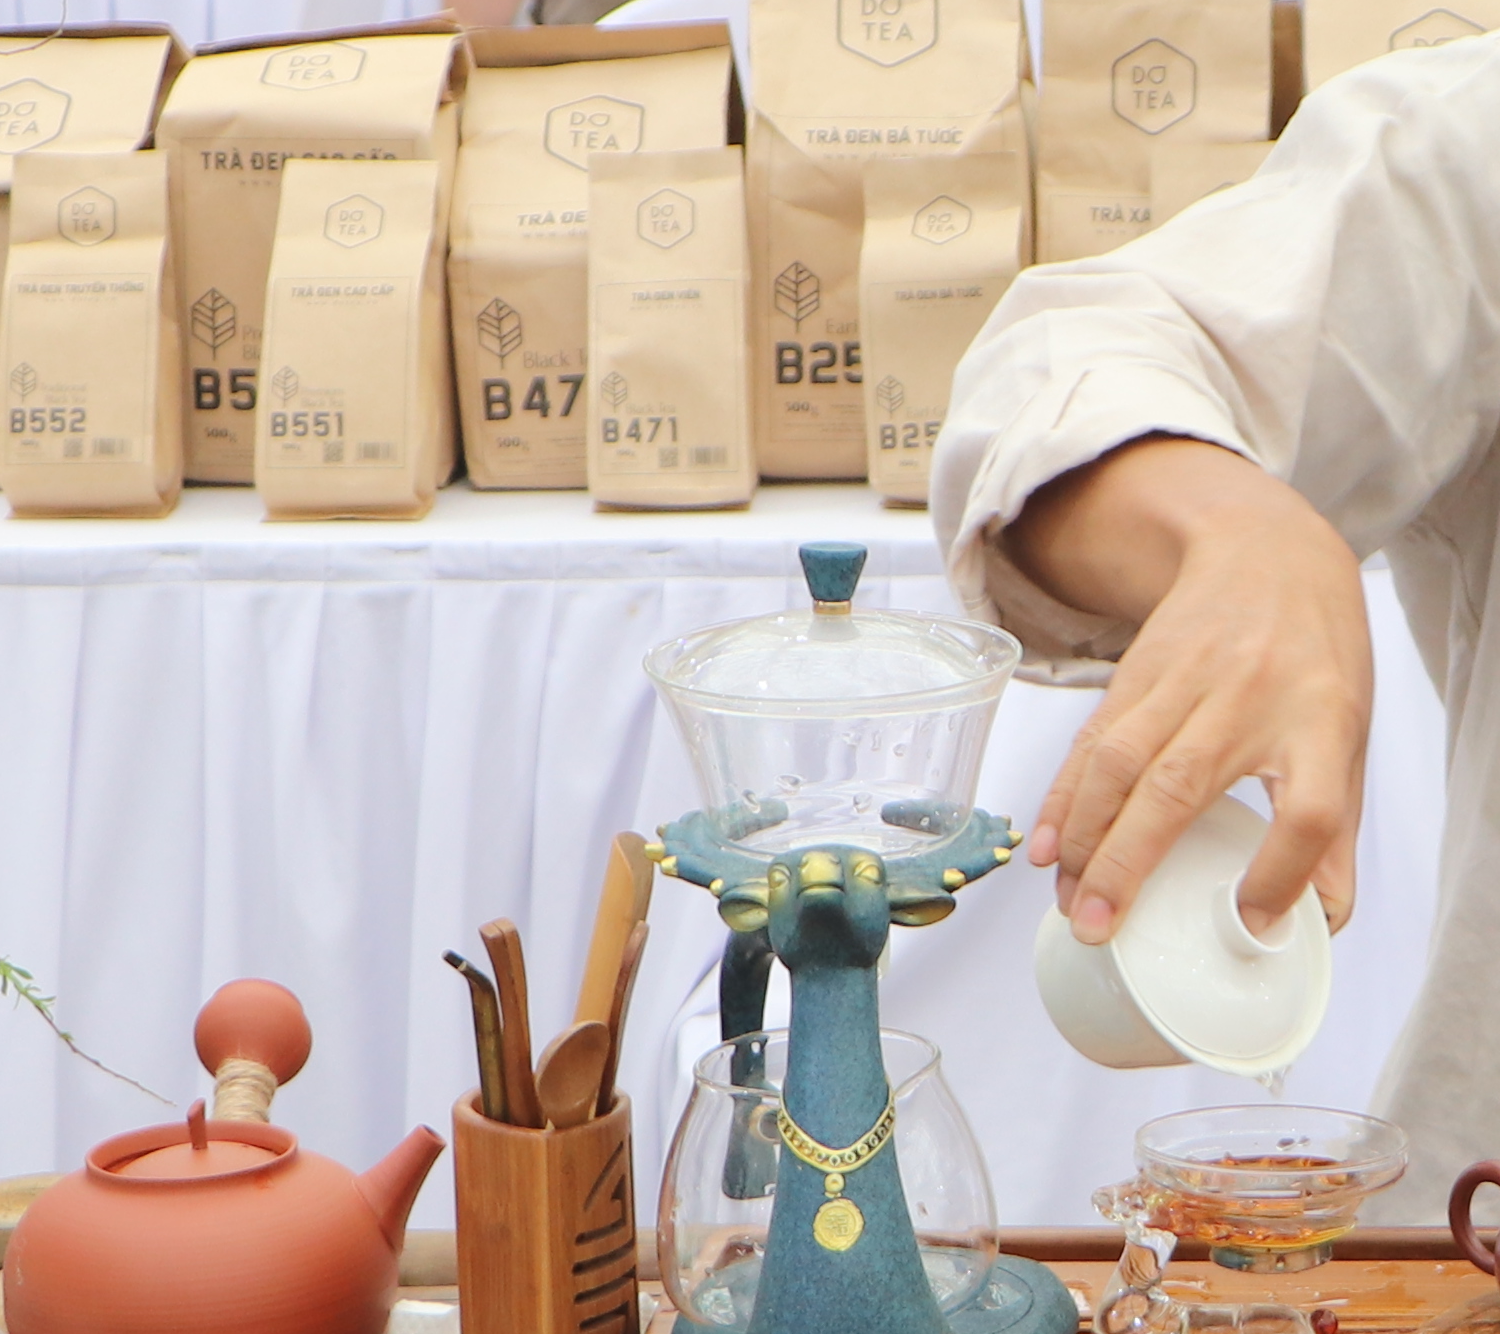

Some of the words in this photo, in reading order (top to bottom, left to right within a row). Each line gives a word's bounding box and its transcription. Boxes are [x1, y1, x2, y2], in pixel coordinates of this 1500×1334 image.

[862, 21, 914, 42] TEA
[287, 69, 336, 81] TEA
[1133, 89, 1177, 110] TEA
[571, 130, 620, 151] TEA
[200, 148, 245, 171] TRÀ
[71, 218, 103, 233] TEA
[338, 223, 367, 236] TEA
[651, 219, 681, 233] TEA
[10, 407, 87, 434] B552
[270, 410, 345, 438] B551
[601, 416, 679, 444] B471
